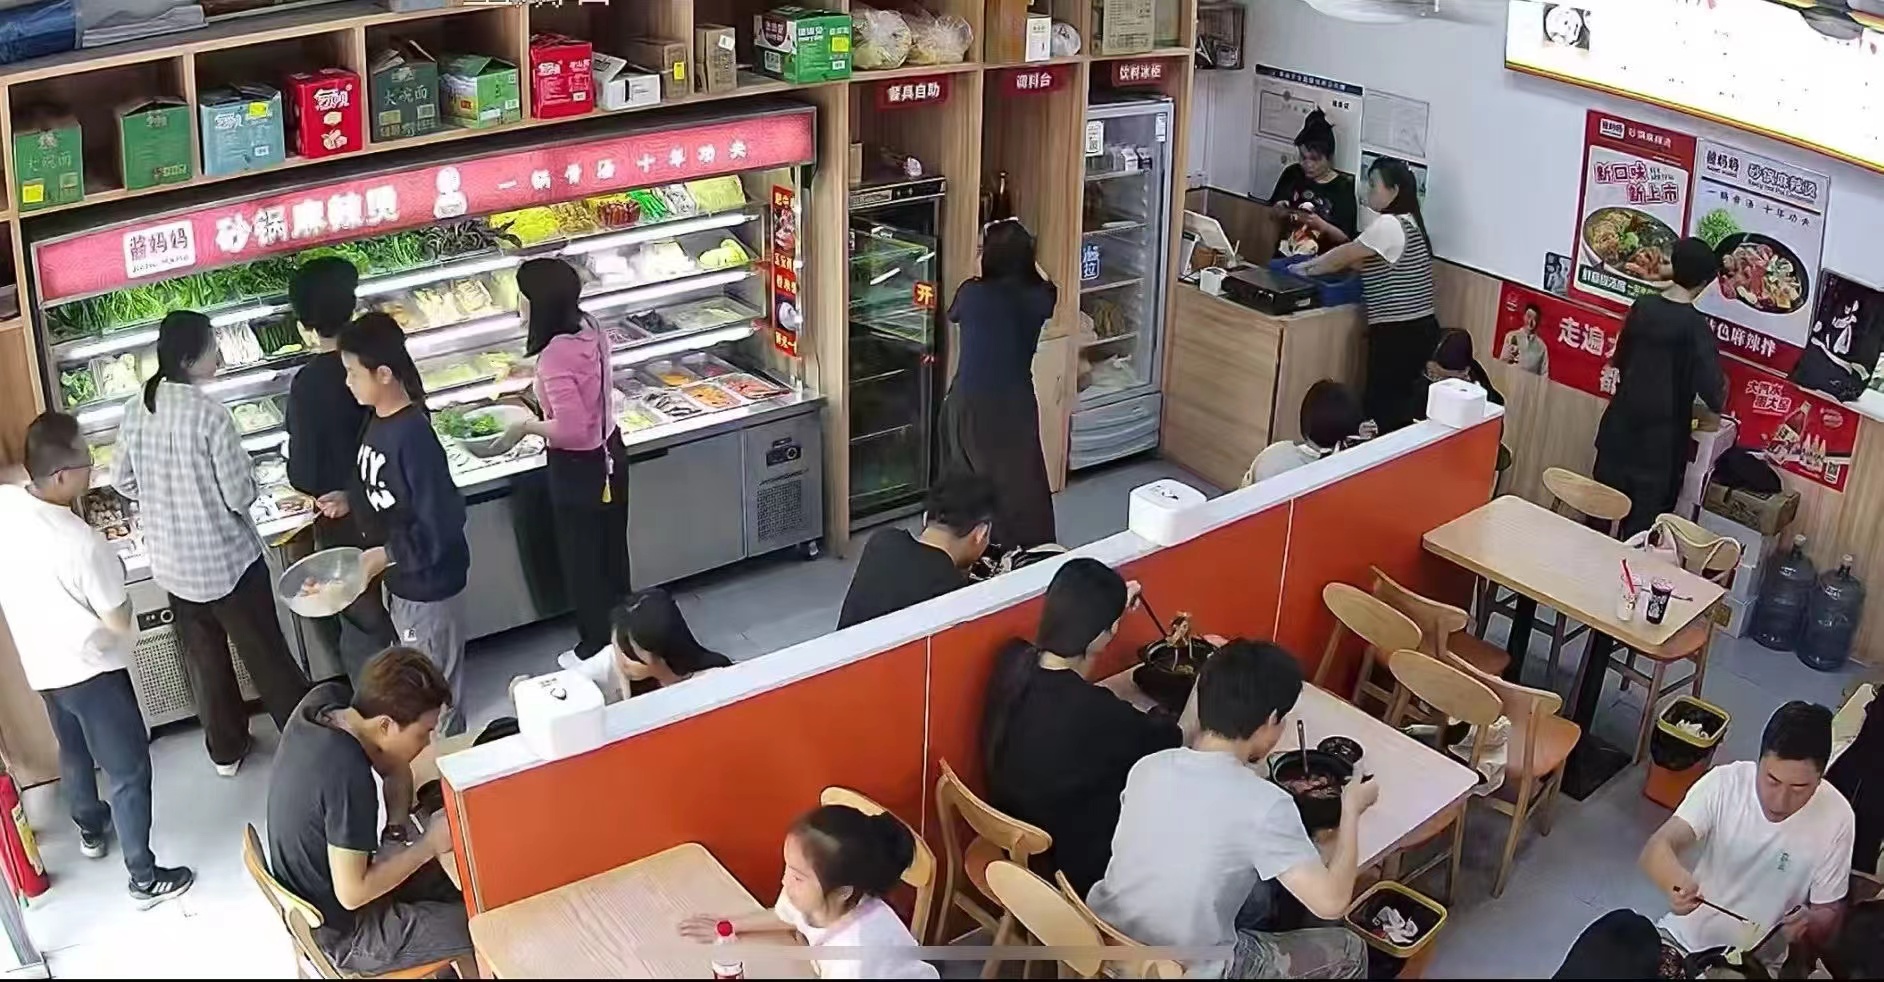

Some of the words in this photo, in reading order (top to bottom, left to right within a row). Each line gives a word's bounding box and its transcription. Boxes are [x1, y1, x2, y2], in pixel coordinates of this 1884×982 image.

[1016, 72, 1051, 89] 调料台
[1119, 63, 1162, 81] 饮料冰柜
[888, 81, 940, 102] 餐具自助
[1594, 161, 1648, 183] 新口味
[1626, 182, 1679, 205] 新上市
[916, 283, 934, 304] 开
